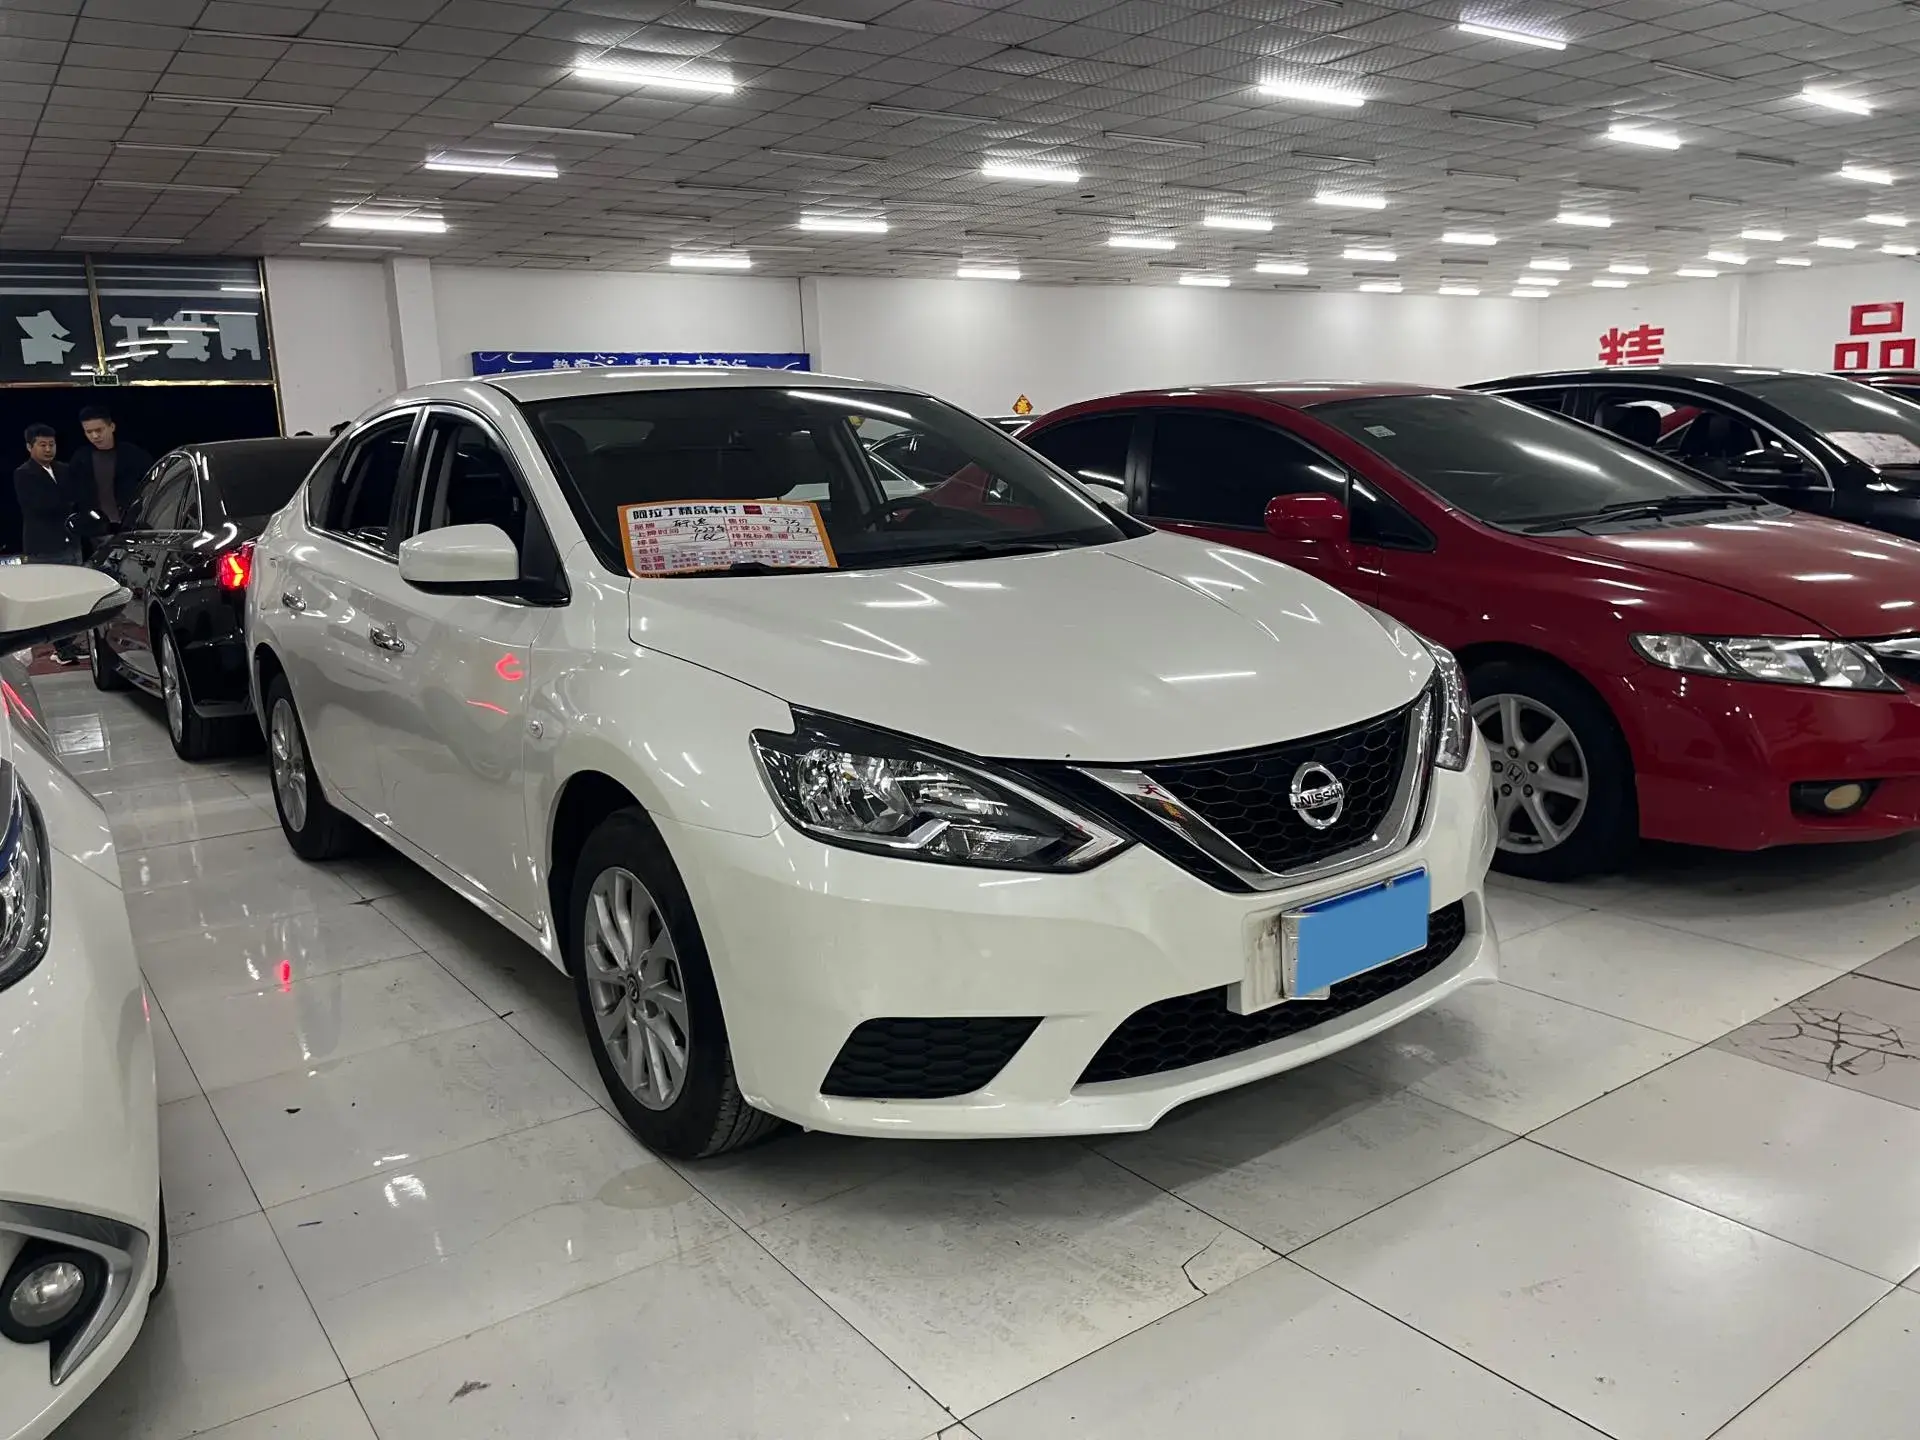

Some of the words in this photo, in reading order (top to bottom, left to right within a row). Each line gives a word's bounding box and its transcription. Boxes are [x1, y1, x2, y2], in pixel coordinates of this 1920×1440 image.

[1834, 301, 1917, 370] 品
[633, 505, 737, 519] 阿拉丁精品车行
[1300, 787, 1343, 805] NISSAN
